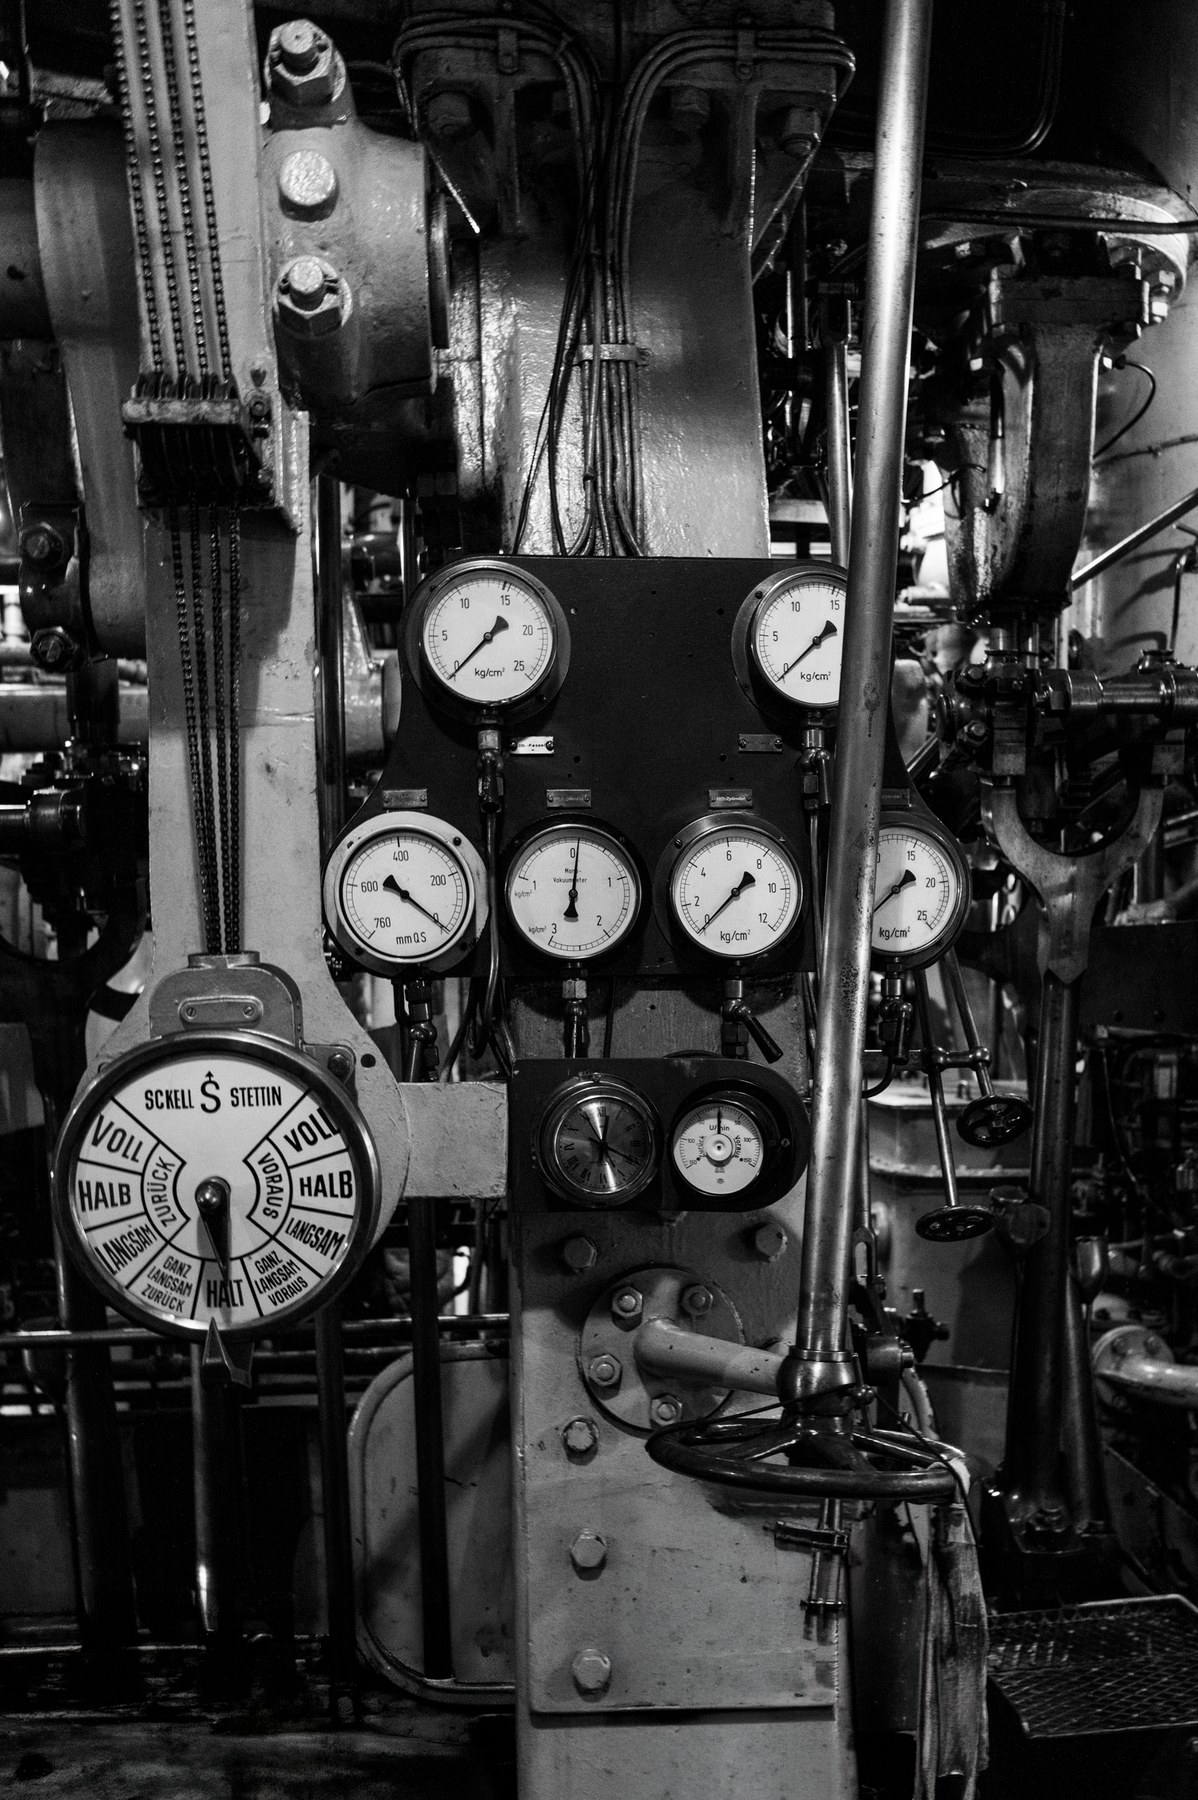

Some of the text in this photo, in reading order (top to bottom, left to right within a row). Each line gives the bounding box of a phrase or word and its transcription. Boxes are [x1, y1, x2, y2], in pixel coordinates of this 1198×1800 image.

[460, 598, 470, 609] 10
[500, 595, 510, 606] 15
[830, 600, 840, 610] 15
[791, 602, 800, 612] 10
[442, 630, 448, 641] 5
[522, 625, 533, 636] 20
[772, 631, 778, 642] 5
[454, 660, 460, 671] 0
[514, 661, 525, 672] 25
[784, 663, 789, 673] 0
[392, 850, 409, 862] 400
[570, 847, 576, 858] 0
[726, 850, 732, 861] 6
[907, 850, 916, 861] 15
[756, 859, 762, 869] 8
[701, 867, 706, 877] 4
[430, 875, 446, 886] 200
[532, 880, 537, 890] 1
[607, 876, 612, 887] 1
[926, 877, 936, 888] 20
[361, 881, 379, 892] 600
[768, 883, 776, 893] 10
[694, 896, 700, 906] 2
[433, 912, 439, 924] 0
[597, 915, 602, 926] 2
[704, 914, 710, 924] 0
[759, 912, 768, 924] 12
[917, 910, 928, 921] 25
[374, 917, 391, 929] 760
[552, 923, 557, 934] 3
[144, 1089, 194, 1110] SCKELL
[230, 1086, 282, 1107] STETTIN
[283, 1107, 341, 1153] VOLL
[91, 1114, 143, 1163] VOLL
[258, 1152, 284, 1219] VORAUS
[300, 1170, 353, 1198] HALB
[78, 1180, 131, 1212] HALB
[147, 1156, 177, 1228] ZURÜCK
[285, 1217, 346, 1260] LANGSAM
[94, 1224, 158, 1276] LANGSAM
[163, 1255, 192, 1279] GANZ
[255, 1250, 283, 1274] GANZ
[147, 1266, 193, 1297] LANGSAM
[255, 1260, 301, 1294] LANGSAM
[207, 1279, 244, 1308] HALT
[268, 1276, 308, 1306] VORAUS
[141, 1283, 185, 1313] ZURÜCK
